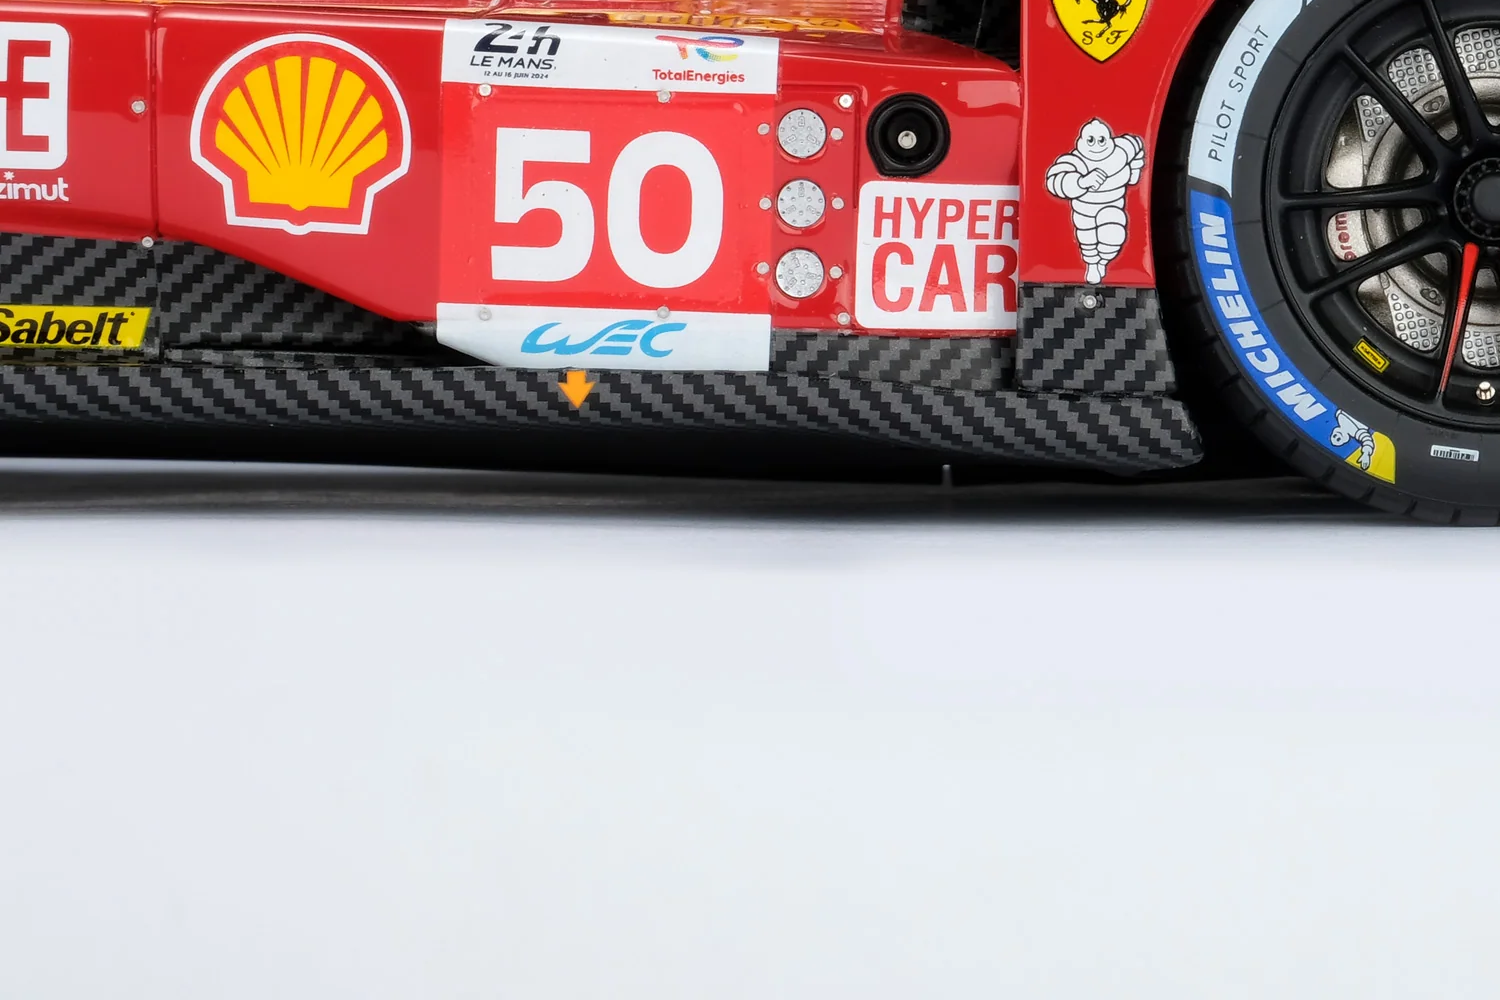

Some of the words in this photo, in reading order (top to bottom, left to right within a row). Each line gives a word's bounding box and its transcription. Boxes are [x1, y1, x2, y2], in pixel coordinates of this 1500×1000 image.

[470, 55, 494, 67] LE
[497, 56, 555, 70] MANS
[652, 69, 745, 85] TotalEnergies
[1207, 99, 1236, 162] PILOT
[1228, 24, 1269, 93] SPORT
[490, 127, 724, 289] 50
[873, 196, 1019, 240] HYPER
[871, 241, 1018, 313] CAR
[521, 319, 688, 358] WEC
[1200, 212, 1327, 421] MICHELIN
